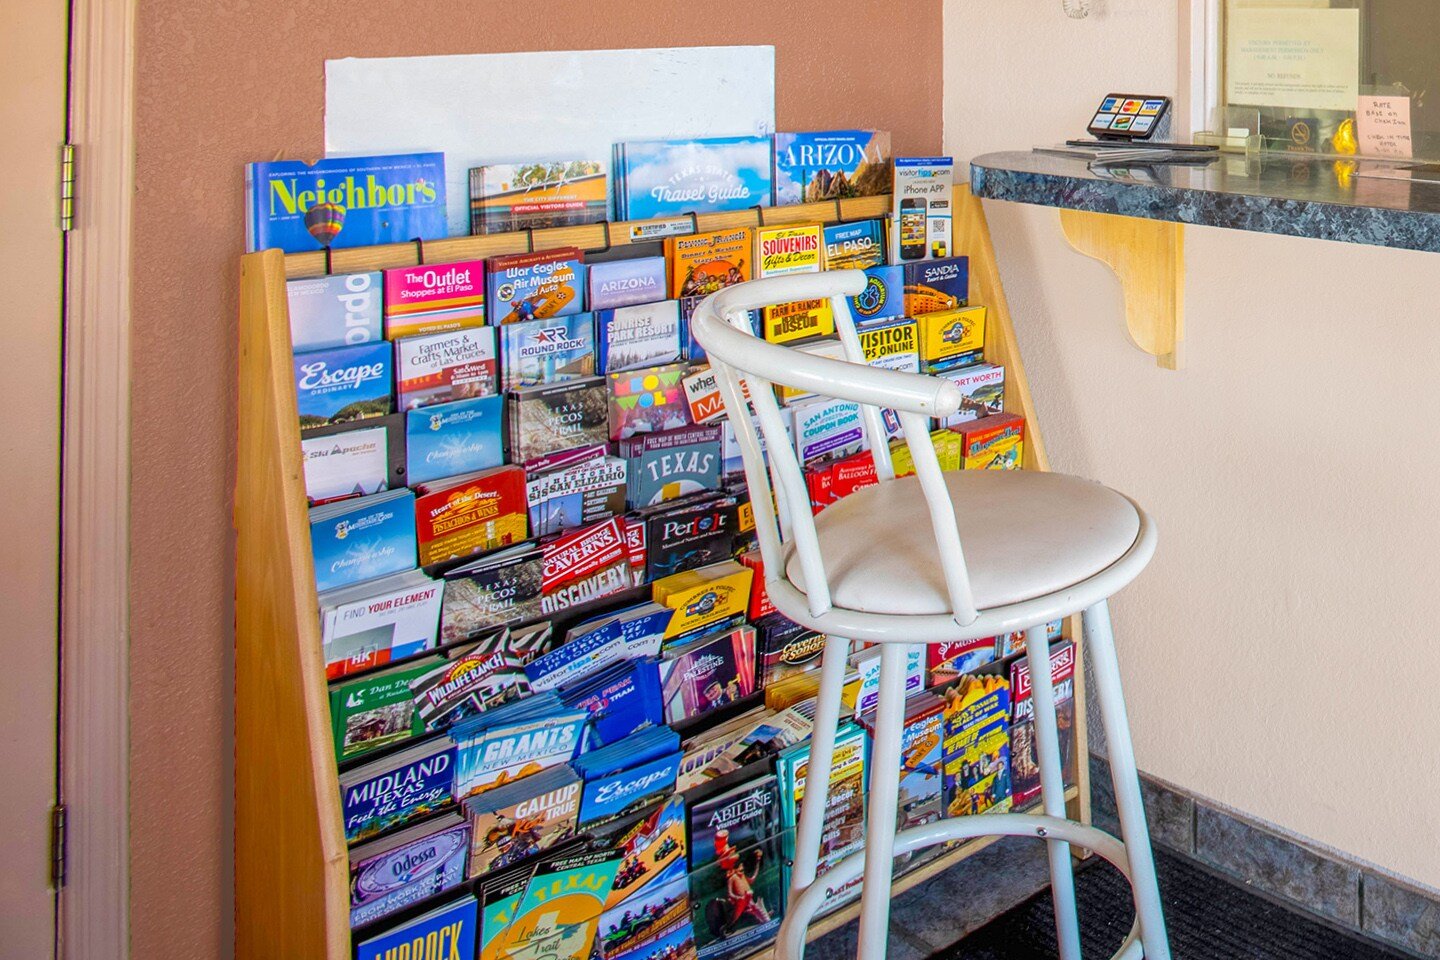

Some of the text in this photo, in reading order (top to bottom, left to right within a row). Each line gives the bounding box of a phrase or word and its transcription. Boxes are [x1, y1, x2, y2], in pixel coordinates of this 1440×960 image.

[784, 144, 884, 166] ARIZONA
[668, 165, 734, 185] TEXAS STATE
[269, 175, 437, 216] Neighbors
[651, 184, 751, 203] Travel Guide
[904, 185, 945, 194] iPhone APP
[763, 235, 818, 256] SOUVENIRS
[828, 238, 871, 256] EL PASO
[506, 261, 568, 279] War Eagles
[764, 253, 815, 269] Gifts & Decor
[405, 268, 471, 288] The Outlet
[514, 272, 575, 290] Air Museum
[601, 277, 656, 293] ARIZONA
[401, 283, 473, 299] Shoppes at El Paso
[539, 285, 558, 297] Auto
[607, 317, 651, 332] SUNRISE
[608, 329, 634, 343] PARK
[411, 342, 479, 366] Crafts Market
[419, 335, 470, 355] Farmers &
[521, 339, 583, 357] ROUND ROCK
[880, 340, 914, 355] ONLINE
[431, 349, 486, 368] of Las Cruces
[300, 362, 384, 389] Escape
[614, 371, 681, 395] MEOW
[972, 371, 1002, 383] WORTH
[804, 403, 859, 428] SAN ANTONIO
[804, 413, 859, 438] COUPON BOOK
[647, 451, 714, 481] TEXAS
[542, 563, 627, 614] DISCOVERY
[343, 589, 436, 620] FIND YOUR ELEMENT
[429, 652, 505, 706] WILDLIFE RANCH
[483, 724, 576, 763] GRANTS
[483, 745, 569, 771] NEW MEXICO
[348, 754, 449, 808] MIDLAND
[594, 766, 672, 804] Escape
[372, 780, 425, 807] TEXAS
[515, 784, 580, 820] GALLUP
[348, 787, 444, 828] Feel the Energy
[545, 801, 576, 822] TRUE
[708, 791, 772, 827] ABILENE
[716, 808, 763, 832] Visitor Guide
[393, 846, 437, 877] Odessa
[534, 873, 609, 901] TEXAS
